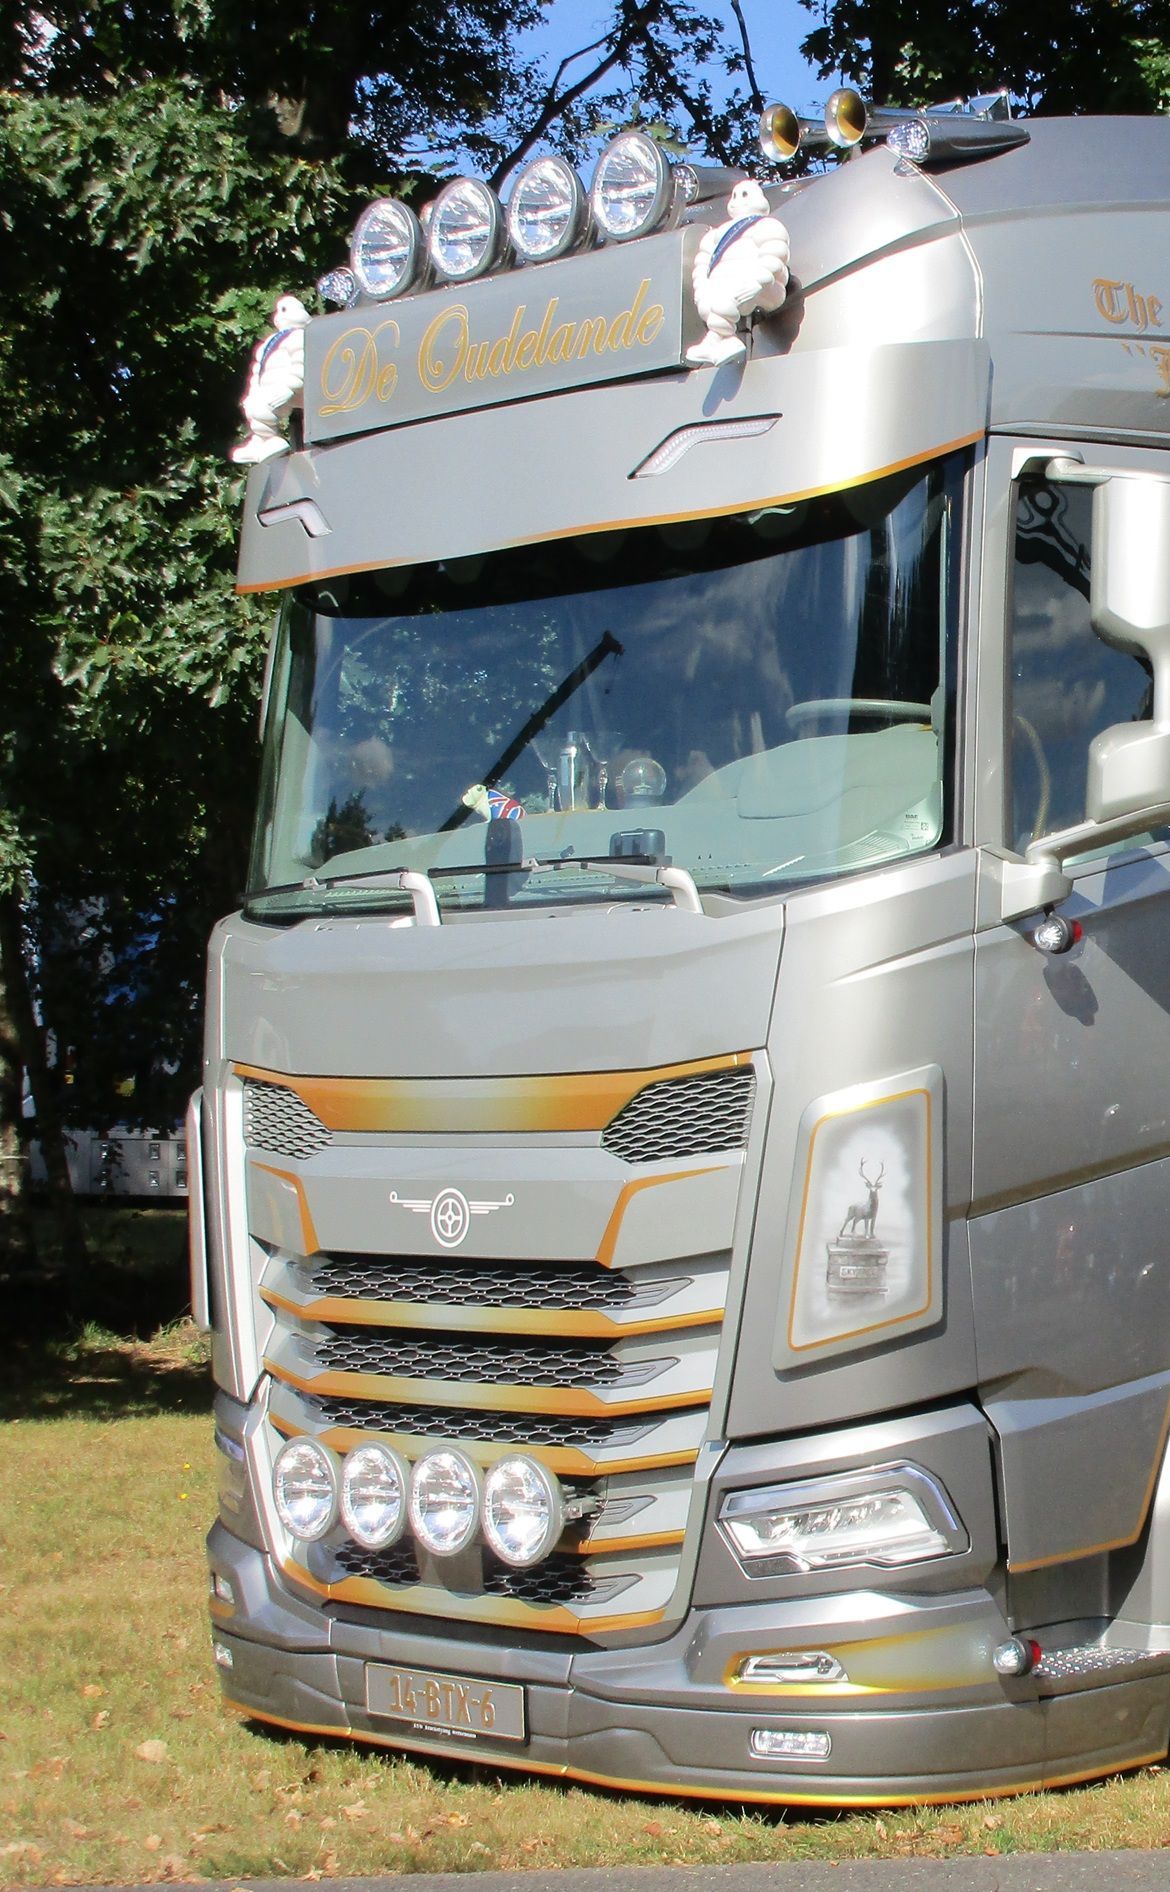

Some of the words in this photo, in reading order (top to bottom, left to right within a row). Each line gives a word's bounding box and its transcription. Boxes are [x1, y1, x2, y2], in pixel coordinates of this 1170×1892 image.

[1092, 278, 1163, 333] The
[319, 320, 400, 417] De
[418, 278, 665, 393] Oudelande
[390, 1675, 495, 1728] 14-BTX-6
